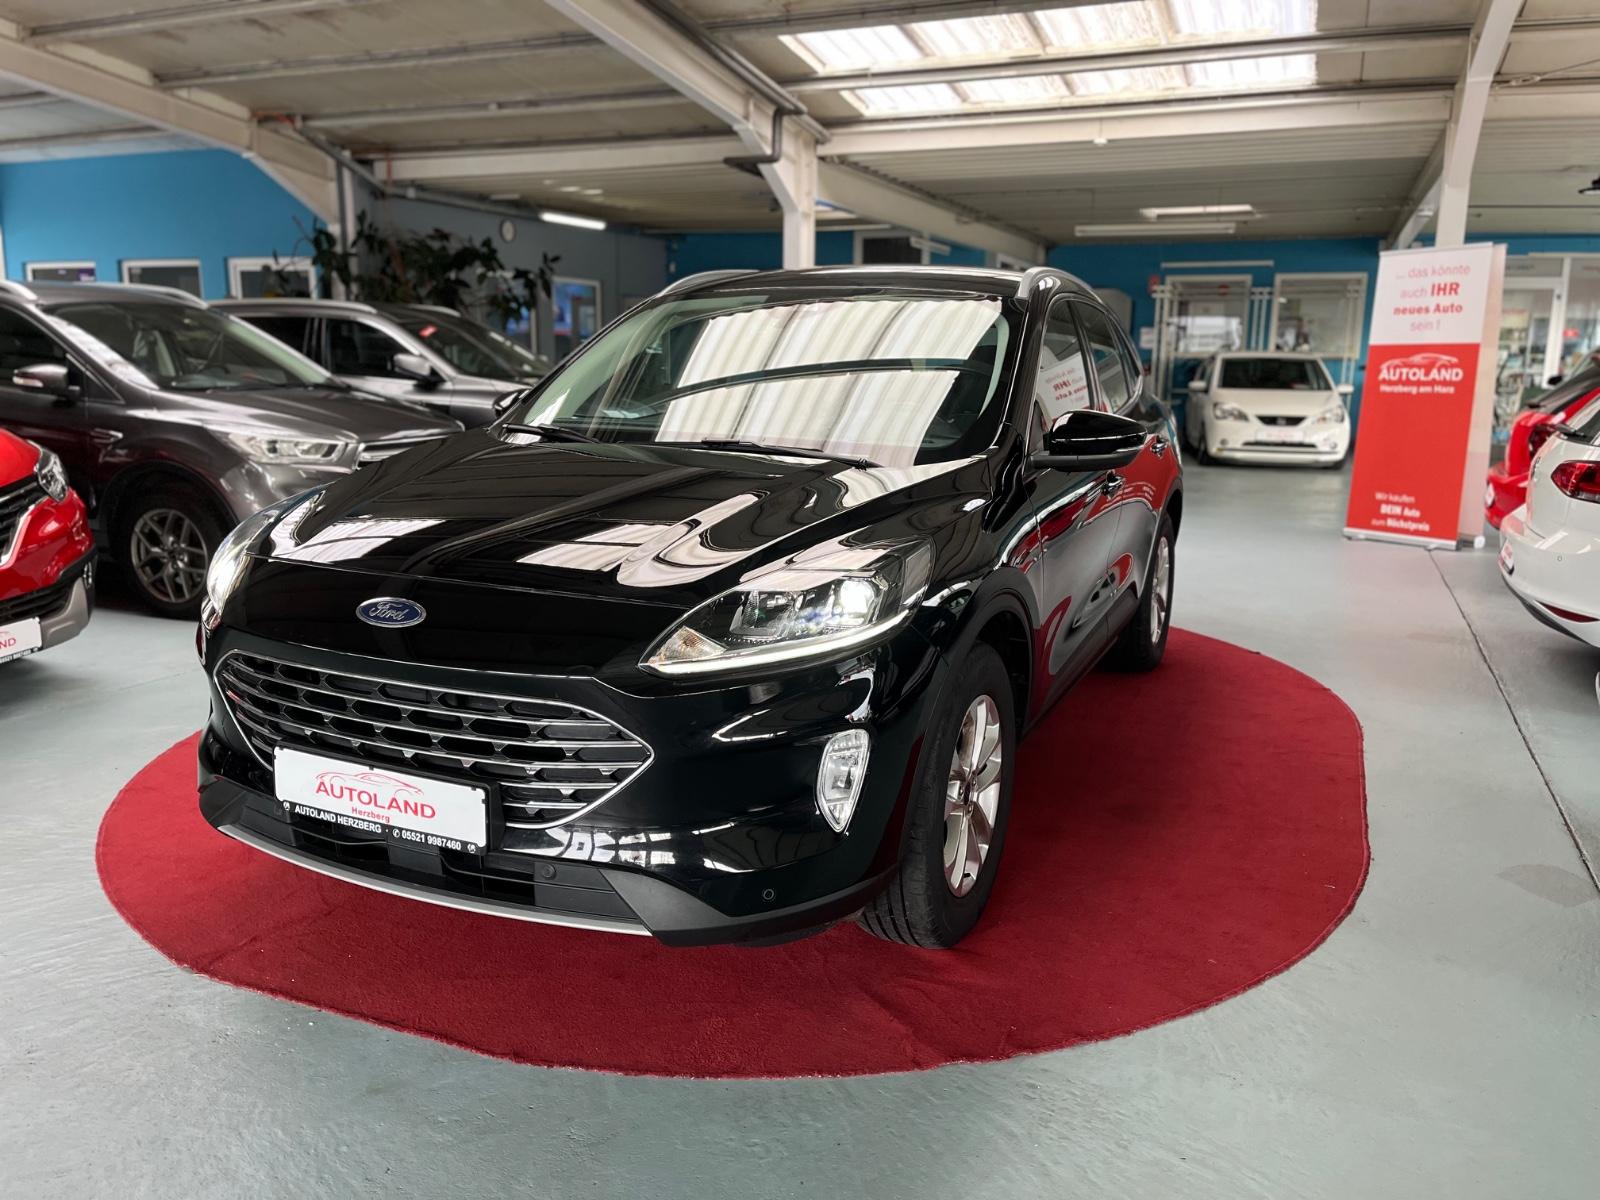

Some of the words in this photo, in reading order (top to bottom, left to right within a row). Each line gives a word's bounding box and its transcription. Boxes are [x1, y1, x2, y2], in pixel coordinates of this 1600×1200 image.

[1400, 288, 1427, 299] auch
[1431, 282, 1460, 297] IHR
[1393, 306, 1430, 316] neues
[1433, 303, 1463, 314] Auto
[1378, 367, 1464, 381] AUTOLAND
[369, 602, 410, 620] Ford
[316, 781, 436, 819] AUTOLAND
[351, 806, 391, 823] Herzberg
[294, 804, 336, 823] AUTOLAND
[337, 814, 382, 833] HERZBERG
[401, 830, 425, 843] 05521
[427, 835, 462, 850] 9987460
